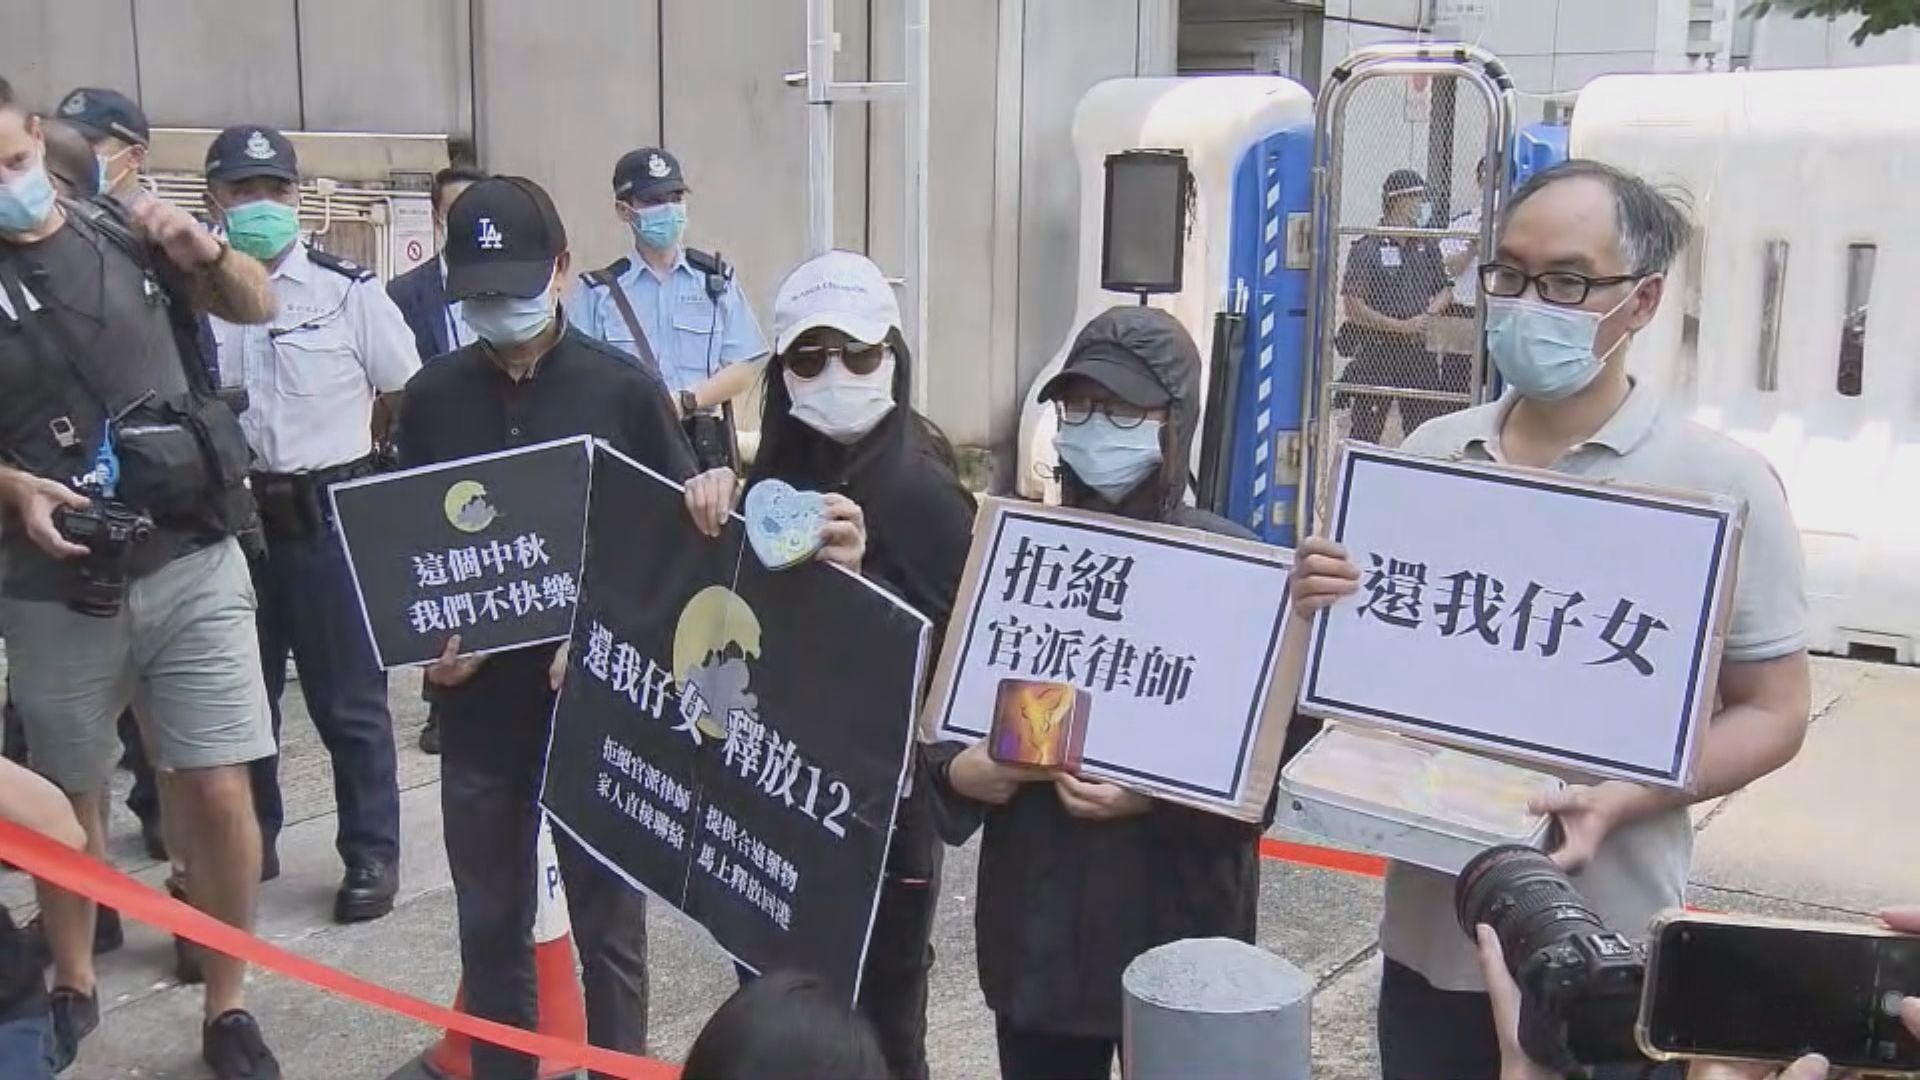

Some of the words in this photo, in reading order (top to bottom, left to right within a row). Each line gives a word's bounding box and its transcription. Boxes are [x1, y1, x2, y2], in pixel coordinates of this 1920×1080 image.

[478, 217, 503, 249] LA
[408, 572, 577, 633] 我們不快樂
[411, 532, 550, 588] 這個中秋
[1002, 536, 1135, 621] 拒絕
[1357, 552, 1669, 676] 還我仔女
[987, 615, 1196, 705] 官派律師
[583, 620, 711, 746] 還我仔女
[722, 709, 850, 838] 釋放12
[597, 772, 686, 850] 家人直接聯絡
[602, 734, 692, 813] 拒絕官派律師
[697, 843, 792, 931] 馬上釋放回港
[704, 804, 799, 893] 提供合適藥物
